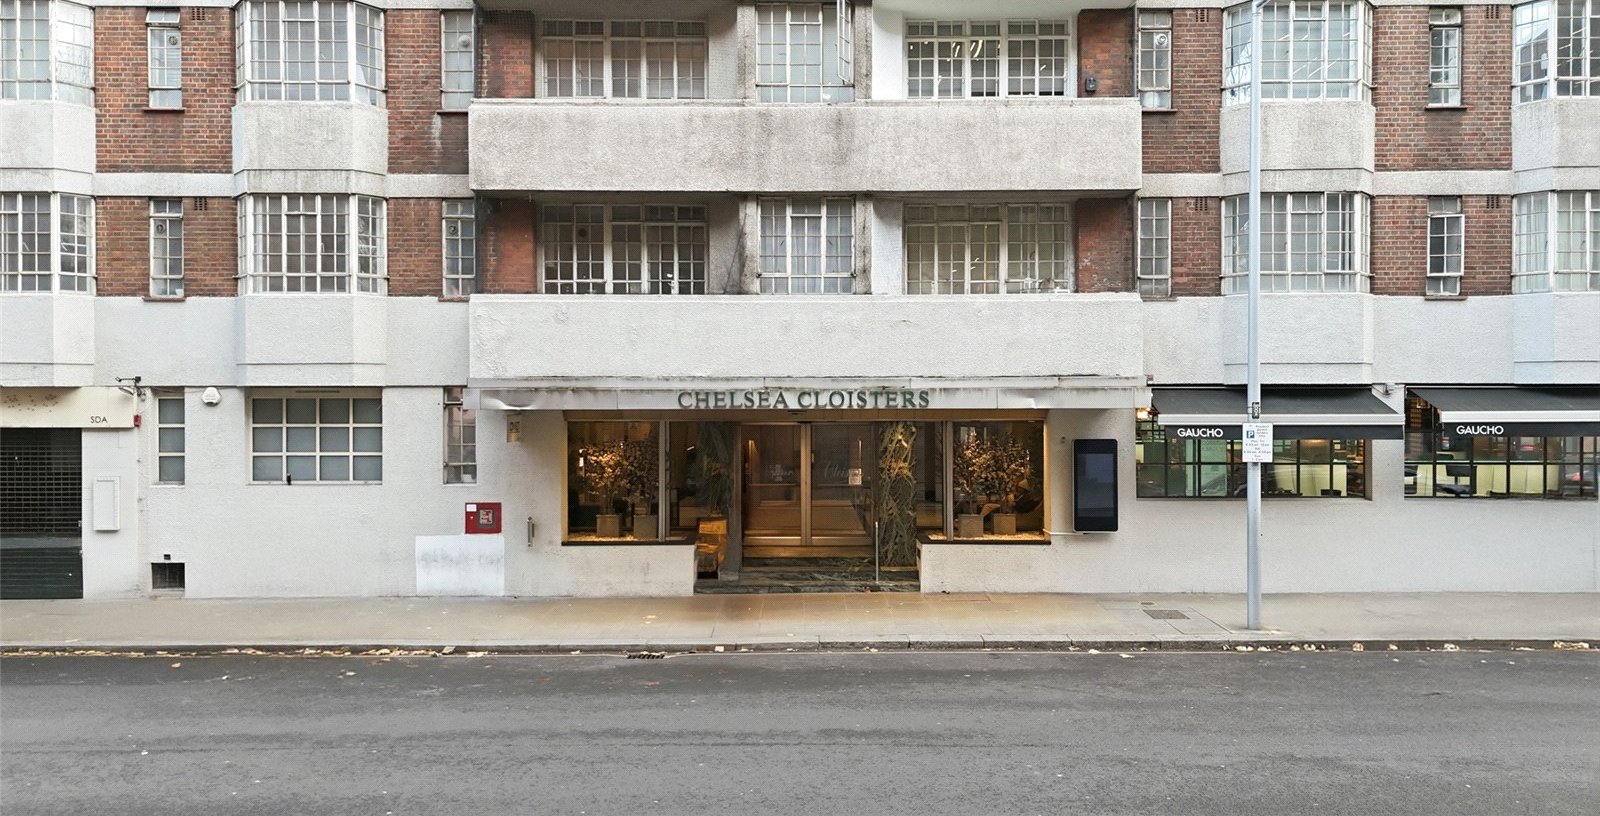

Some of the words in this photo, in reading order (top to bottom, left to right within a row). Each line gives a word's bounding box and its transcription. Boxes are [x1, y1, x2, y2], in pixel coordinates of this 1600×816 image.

[677, 390, 790, 409] CHELSEA
[797, 390, 930, 409] CLOISTERS
[1177, 427, 1224, 438] GAUCHO
[1456, 424, 1504, 435] GAUCHO
